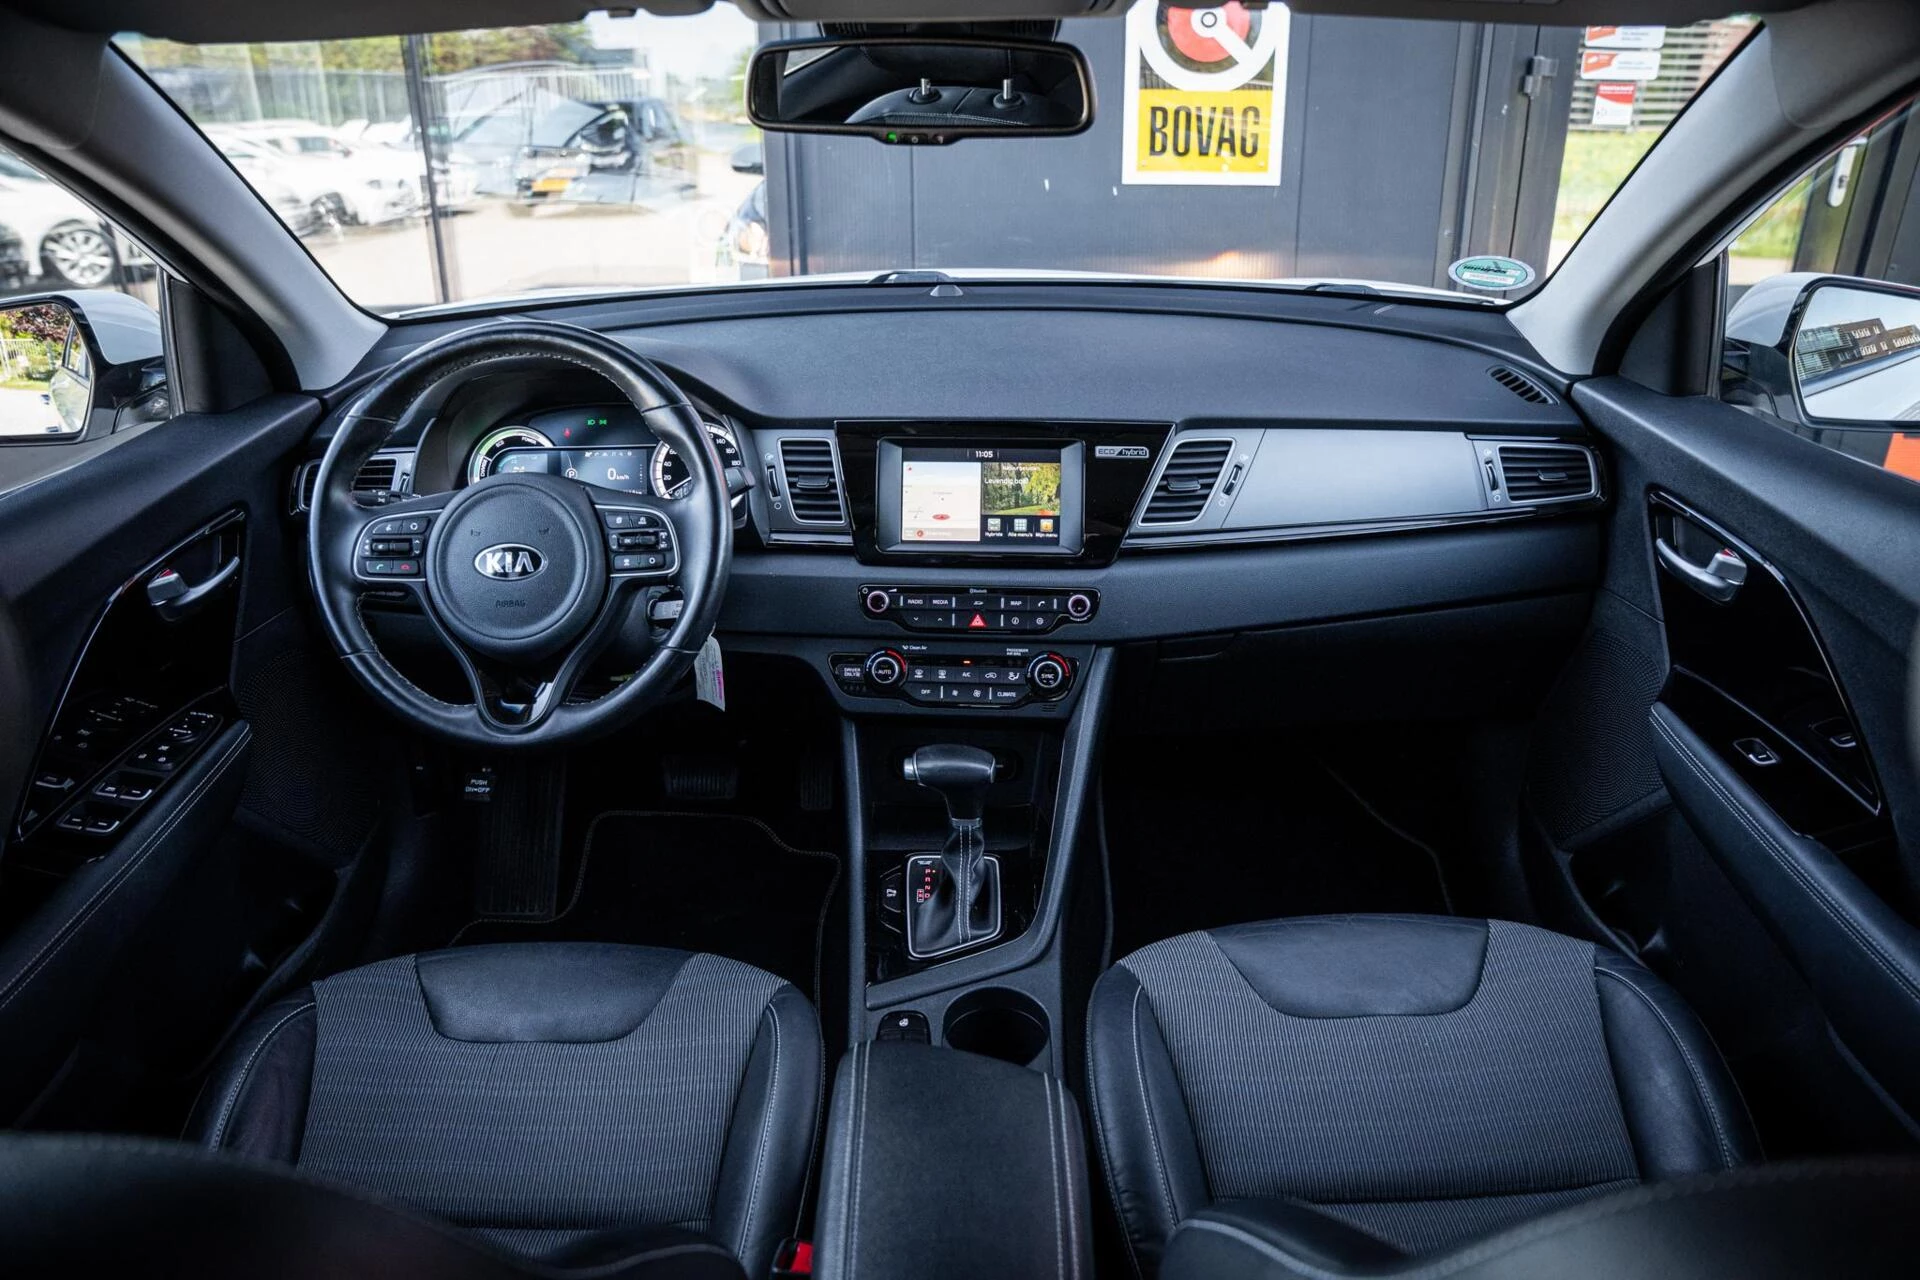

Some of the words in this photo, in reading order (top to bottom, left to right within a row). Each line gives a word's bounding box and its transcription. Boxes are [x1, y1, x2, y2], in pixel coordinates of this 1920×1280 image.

[1149, 105, 1260, 158] BOVAG
[975, 450, 993, 458] 11:05
[1122, 448, 1146, 457] hybrid
[607, 467, 617, 480] 0
[486, 551, 535, 573] KIA
